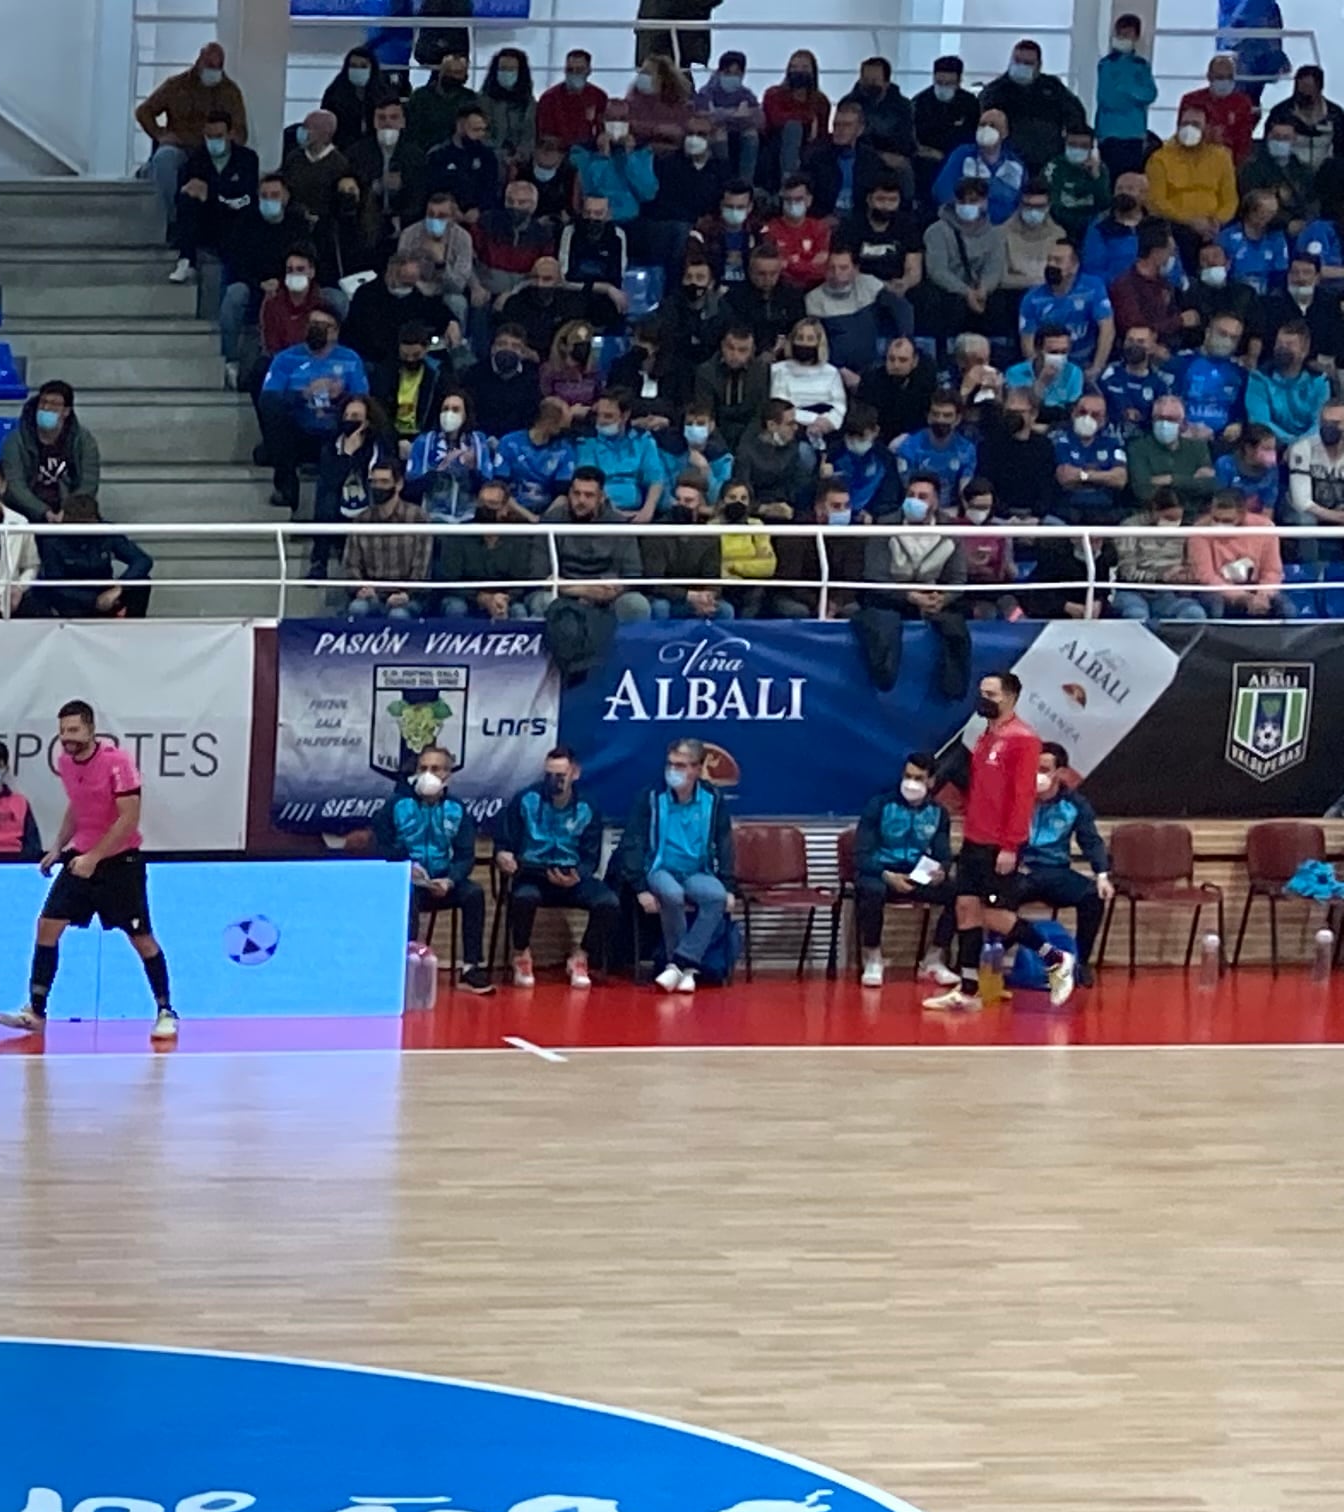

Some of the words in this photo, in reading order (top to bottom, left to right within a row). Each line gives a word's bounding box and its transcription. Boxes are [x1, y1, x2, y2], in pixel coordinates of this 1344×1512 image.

[314, 626, 409, 656] PASIÓN
[424, 632, 544, 656] VINATERA
[659, 637, 751, 676] Viña
[1058, 639, 1131, 705] ALBALI
[602, 669, 808, 721] ALBALI
[321, 797, 386, 818] SIEMP
